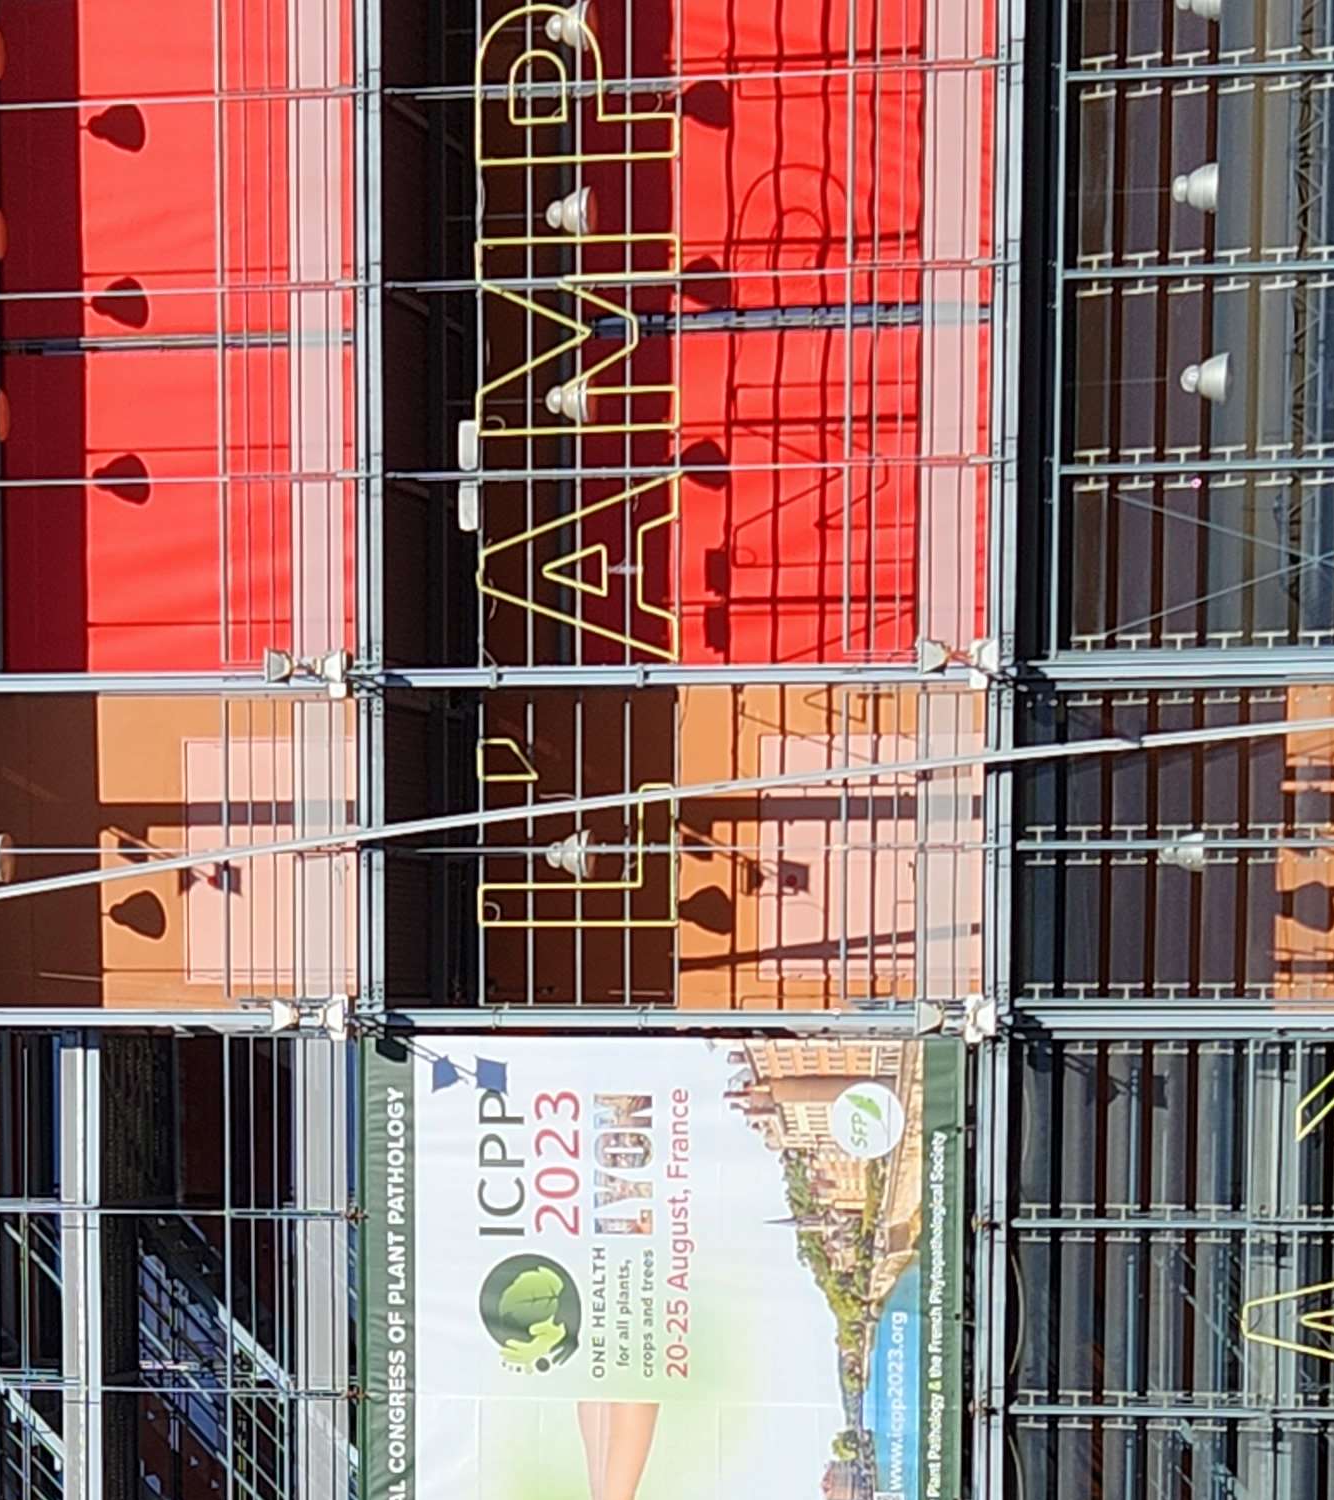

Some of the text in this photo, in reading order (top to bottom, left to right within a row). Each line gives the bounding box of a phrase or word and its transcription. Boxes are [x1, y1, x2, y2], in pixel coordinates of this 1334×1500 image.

[385, 1086, 405, 1224] PATHOLOGY
[477, 1090, 525, 1237] ICPP
[534, 1090, 580, 1236] 2023
[593, 1093, 653, 1236] LYON
[851, 1111, 868, 1148] SFP
[930, 1132, 947, 1181] Society
[387, 1231, 406, 1304] PLANT
[667, 1088, 695, 1378] 20-25 August, France
[929, 1184, 947, 1304] Phytopathological
[387, 1311, 406, 1344] OF
[592, 1246, 606, 1378] ONE HEALTH
[616, 1320, 630, 1340] all
[616, 1345, 630, 1367] for
[640, 1249, 655, 1378] crops and trees
[928, 1306, 943, 1352] French
[387, 1350, 407, 1474] CONGRESS
[887, 1311, 908, 1491] www.icpp2023.org
[928, 1356, 943, 1378] the
[927, 1394, 945, 1460] Pathology
[926, 1462, 942, 1496] Plant
